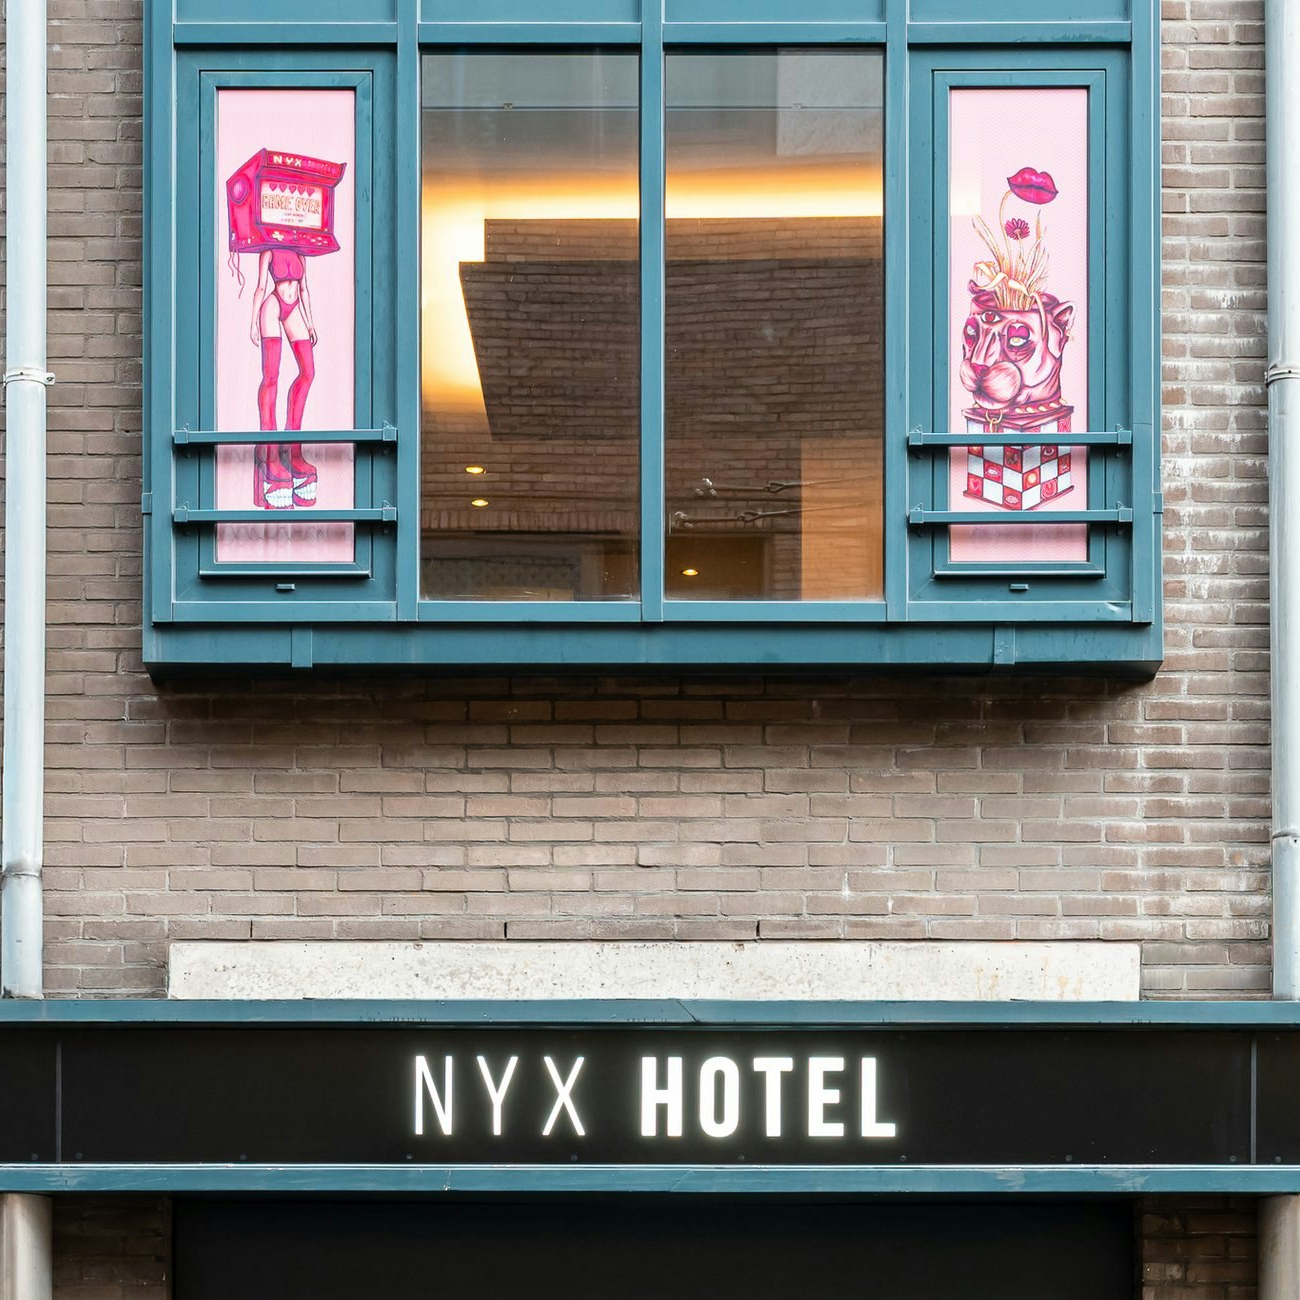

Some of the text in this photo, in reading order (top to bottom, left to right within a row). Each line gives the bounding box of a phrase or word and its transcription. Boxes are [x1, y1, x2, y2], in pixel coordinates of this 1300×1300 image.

[273, 155, 302, 167] NYX
[262, 193, 321, 215] GAME OVER
[415, 1055, 896, 1138] NYX HOTEL
